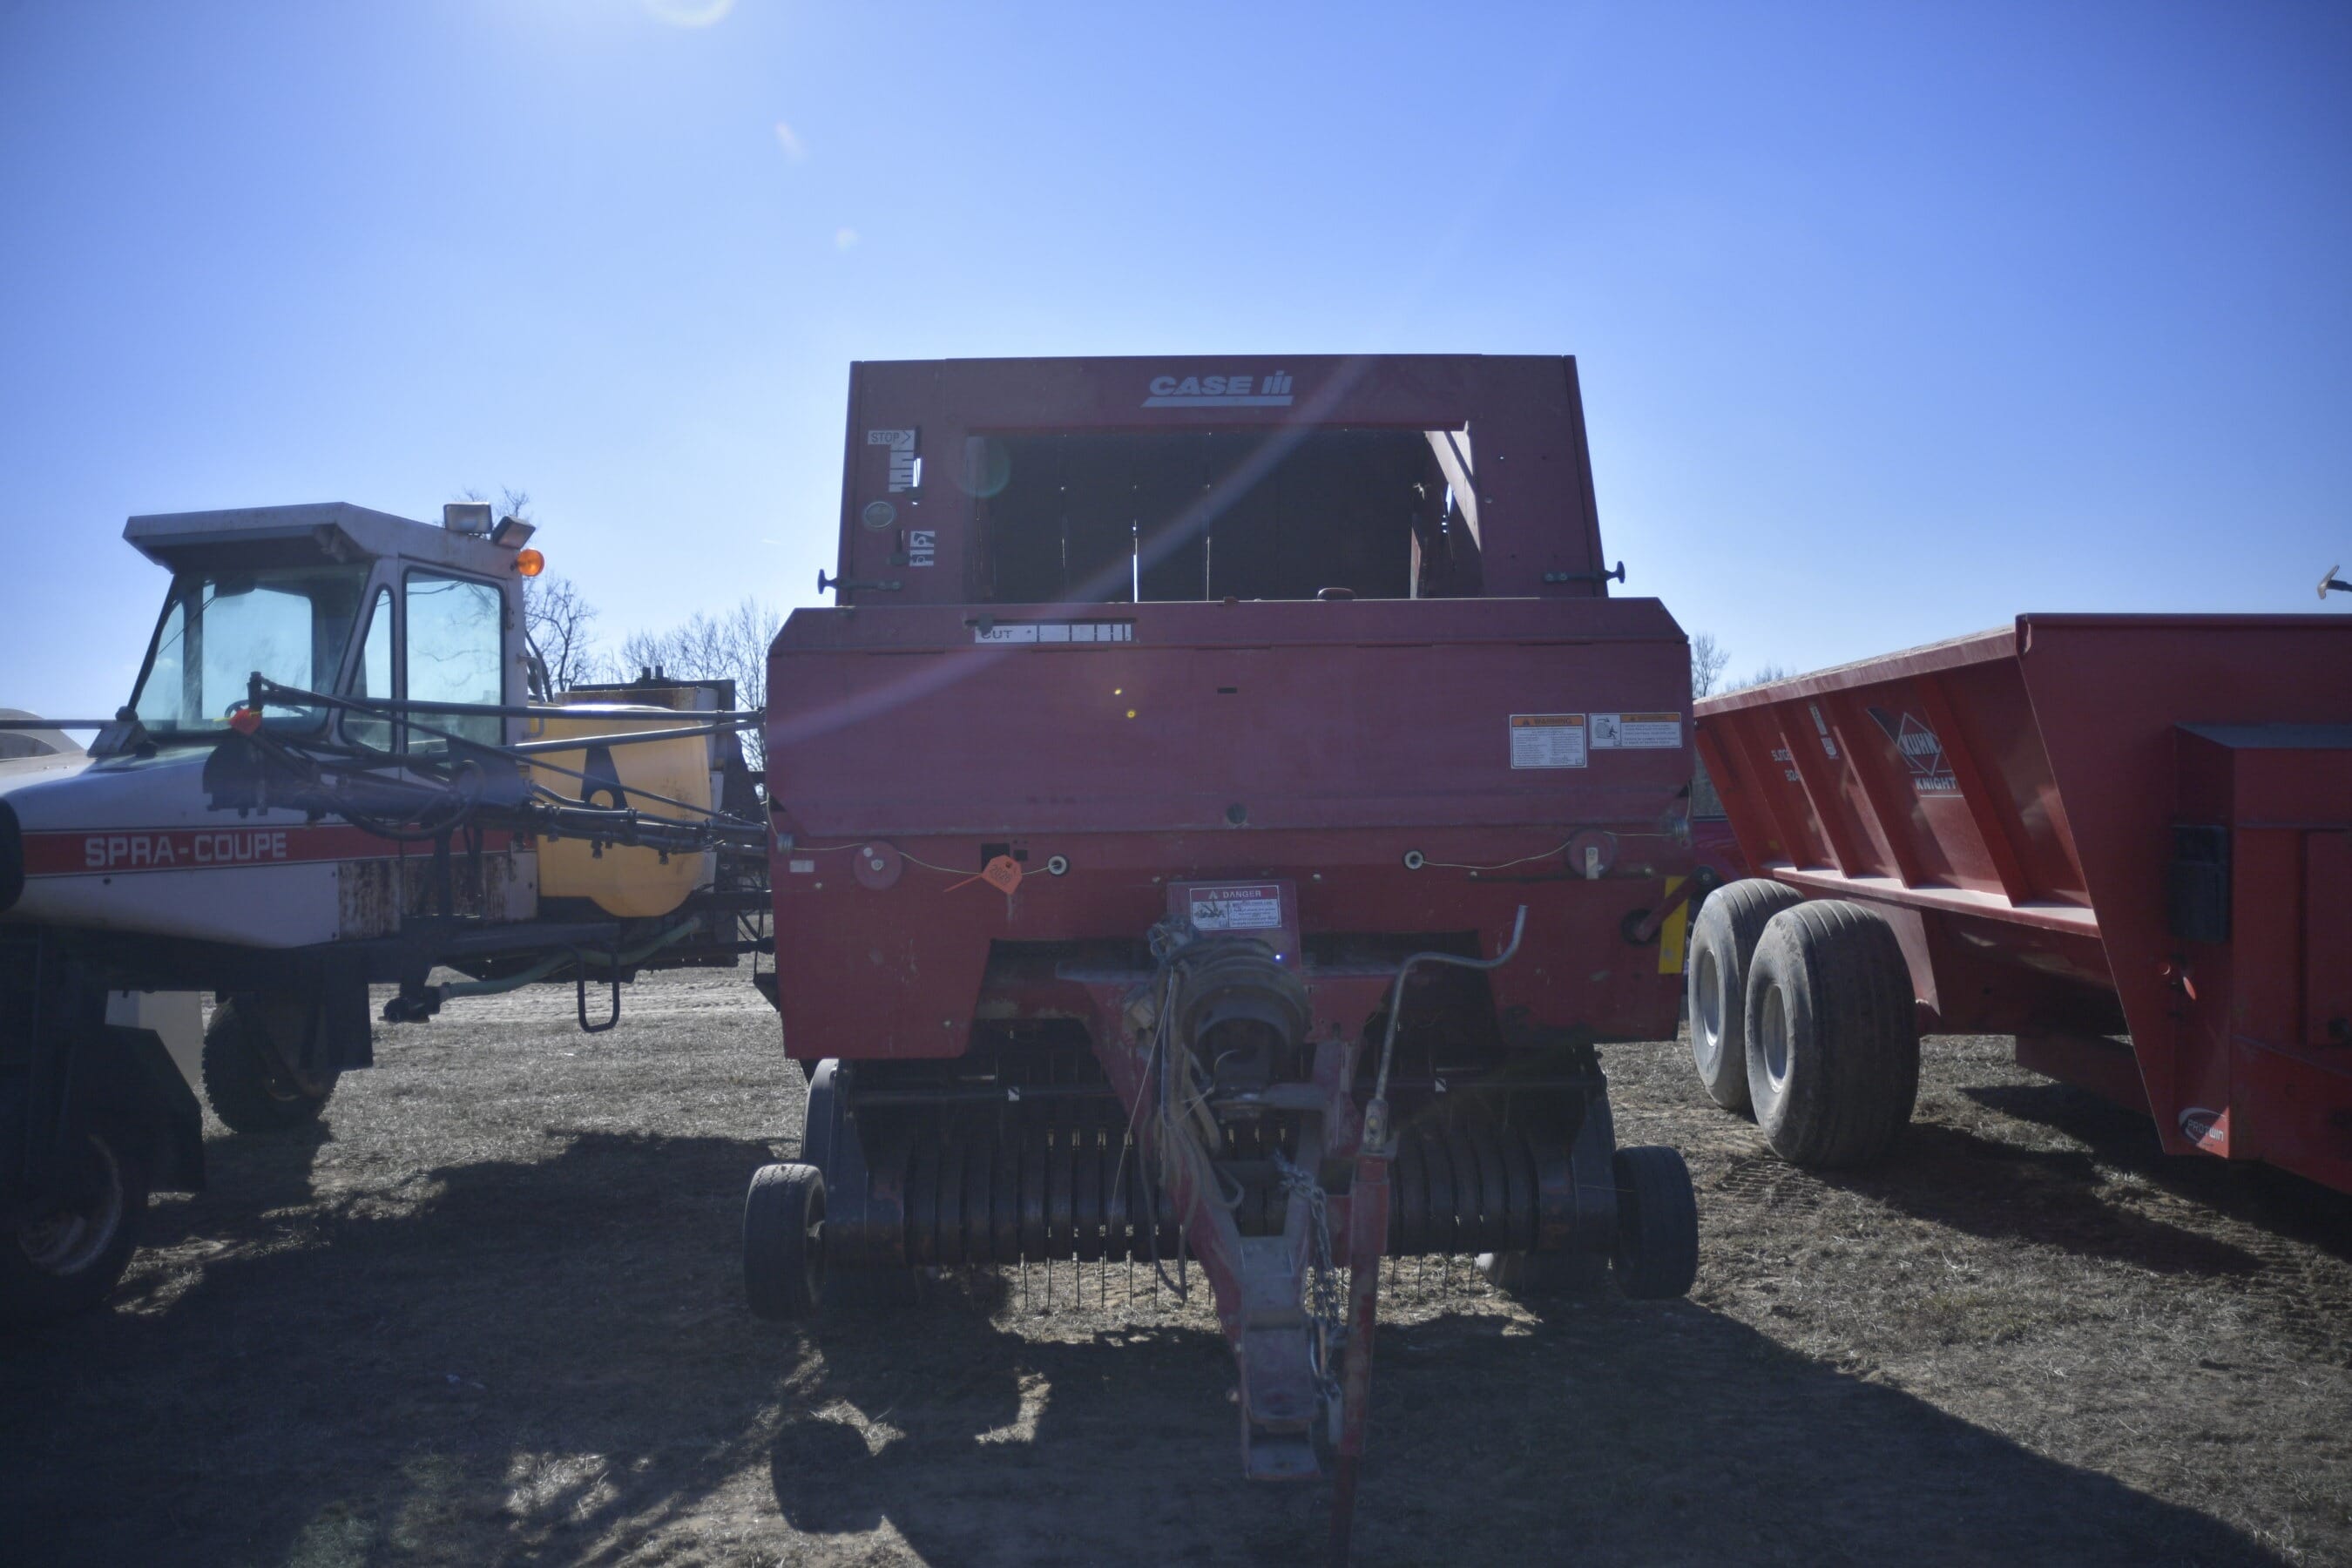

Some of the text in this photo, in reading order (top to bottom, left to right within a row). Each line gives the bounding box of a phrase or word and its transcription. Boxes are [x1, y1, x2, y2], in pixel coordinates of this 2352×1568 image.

[1149, 375, 1254, 395] CASE
[871, 432, 900, 443] STOP
[1901, 732, 1939, 756] KUHN
[1915, 776, 1957, 790] KNIGHT
[85, 832, 287, 867] SPRA-COUPE
[1222, 889, 1262, 899] DANGER
